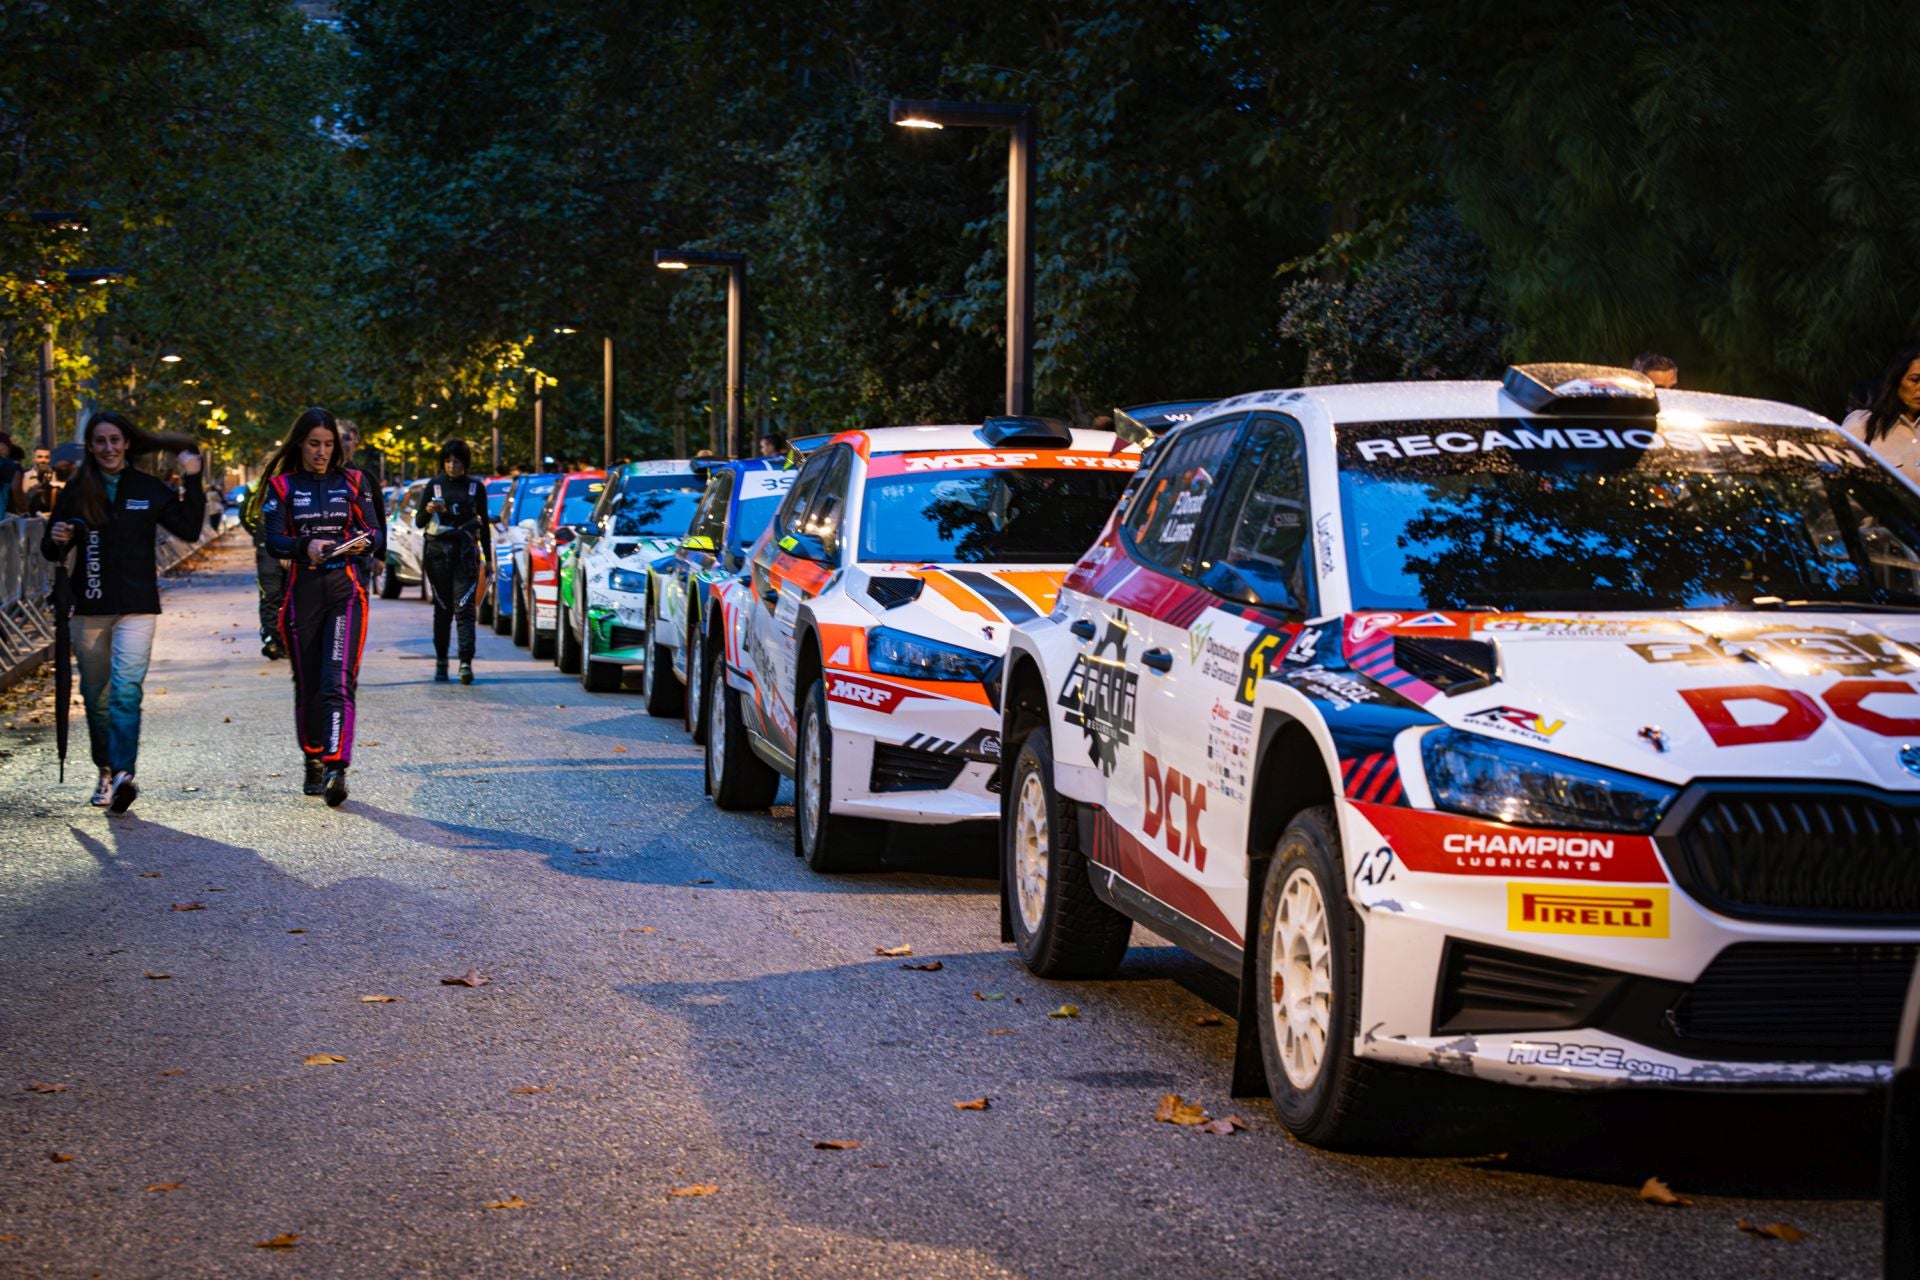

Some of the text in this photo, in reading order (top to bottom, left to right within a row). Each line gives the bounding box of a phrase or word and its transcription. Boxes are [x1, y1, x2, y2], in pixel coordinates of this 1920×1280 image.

[904, 453, 1038, 472] MRF
[1245, 634, 1281, 701] 5
[829, 679, 892, 706] MRF
[1142, 750, 1207, 873] DCK
[1443, 834, 1615, 859] CHAMPION
[1456, 857, 1602, 872] LUBRICANTS
[1522, 893, 1654, 928] PIRELLI
